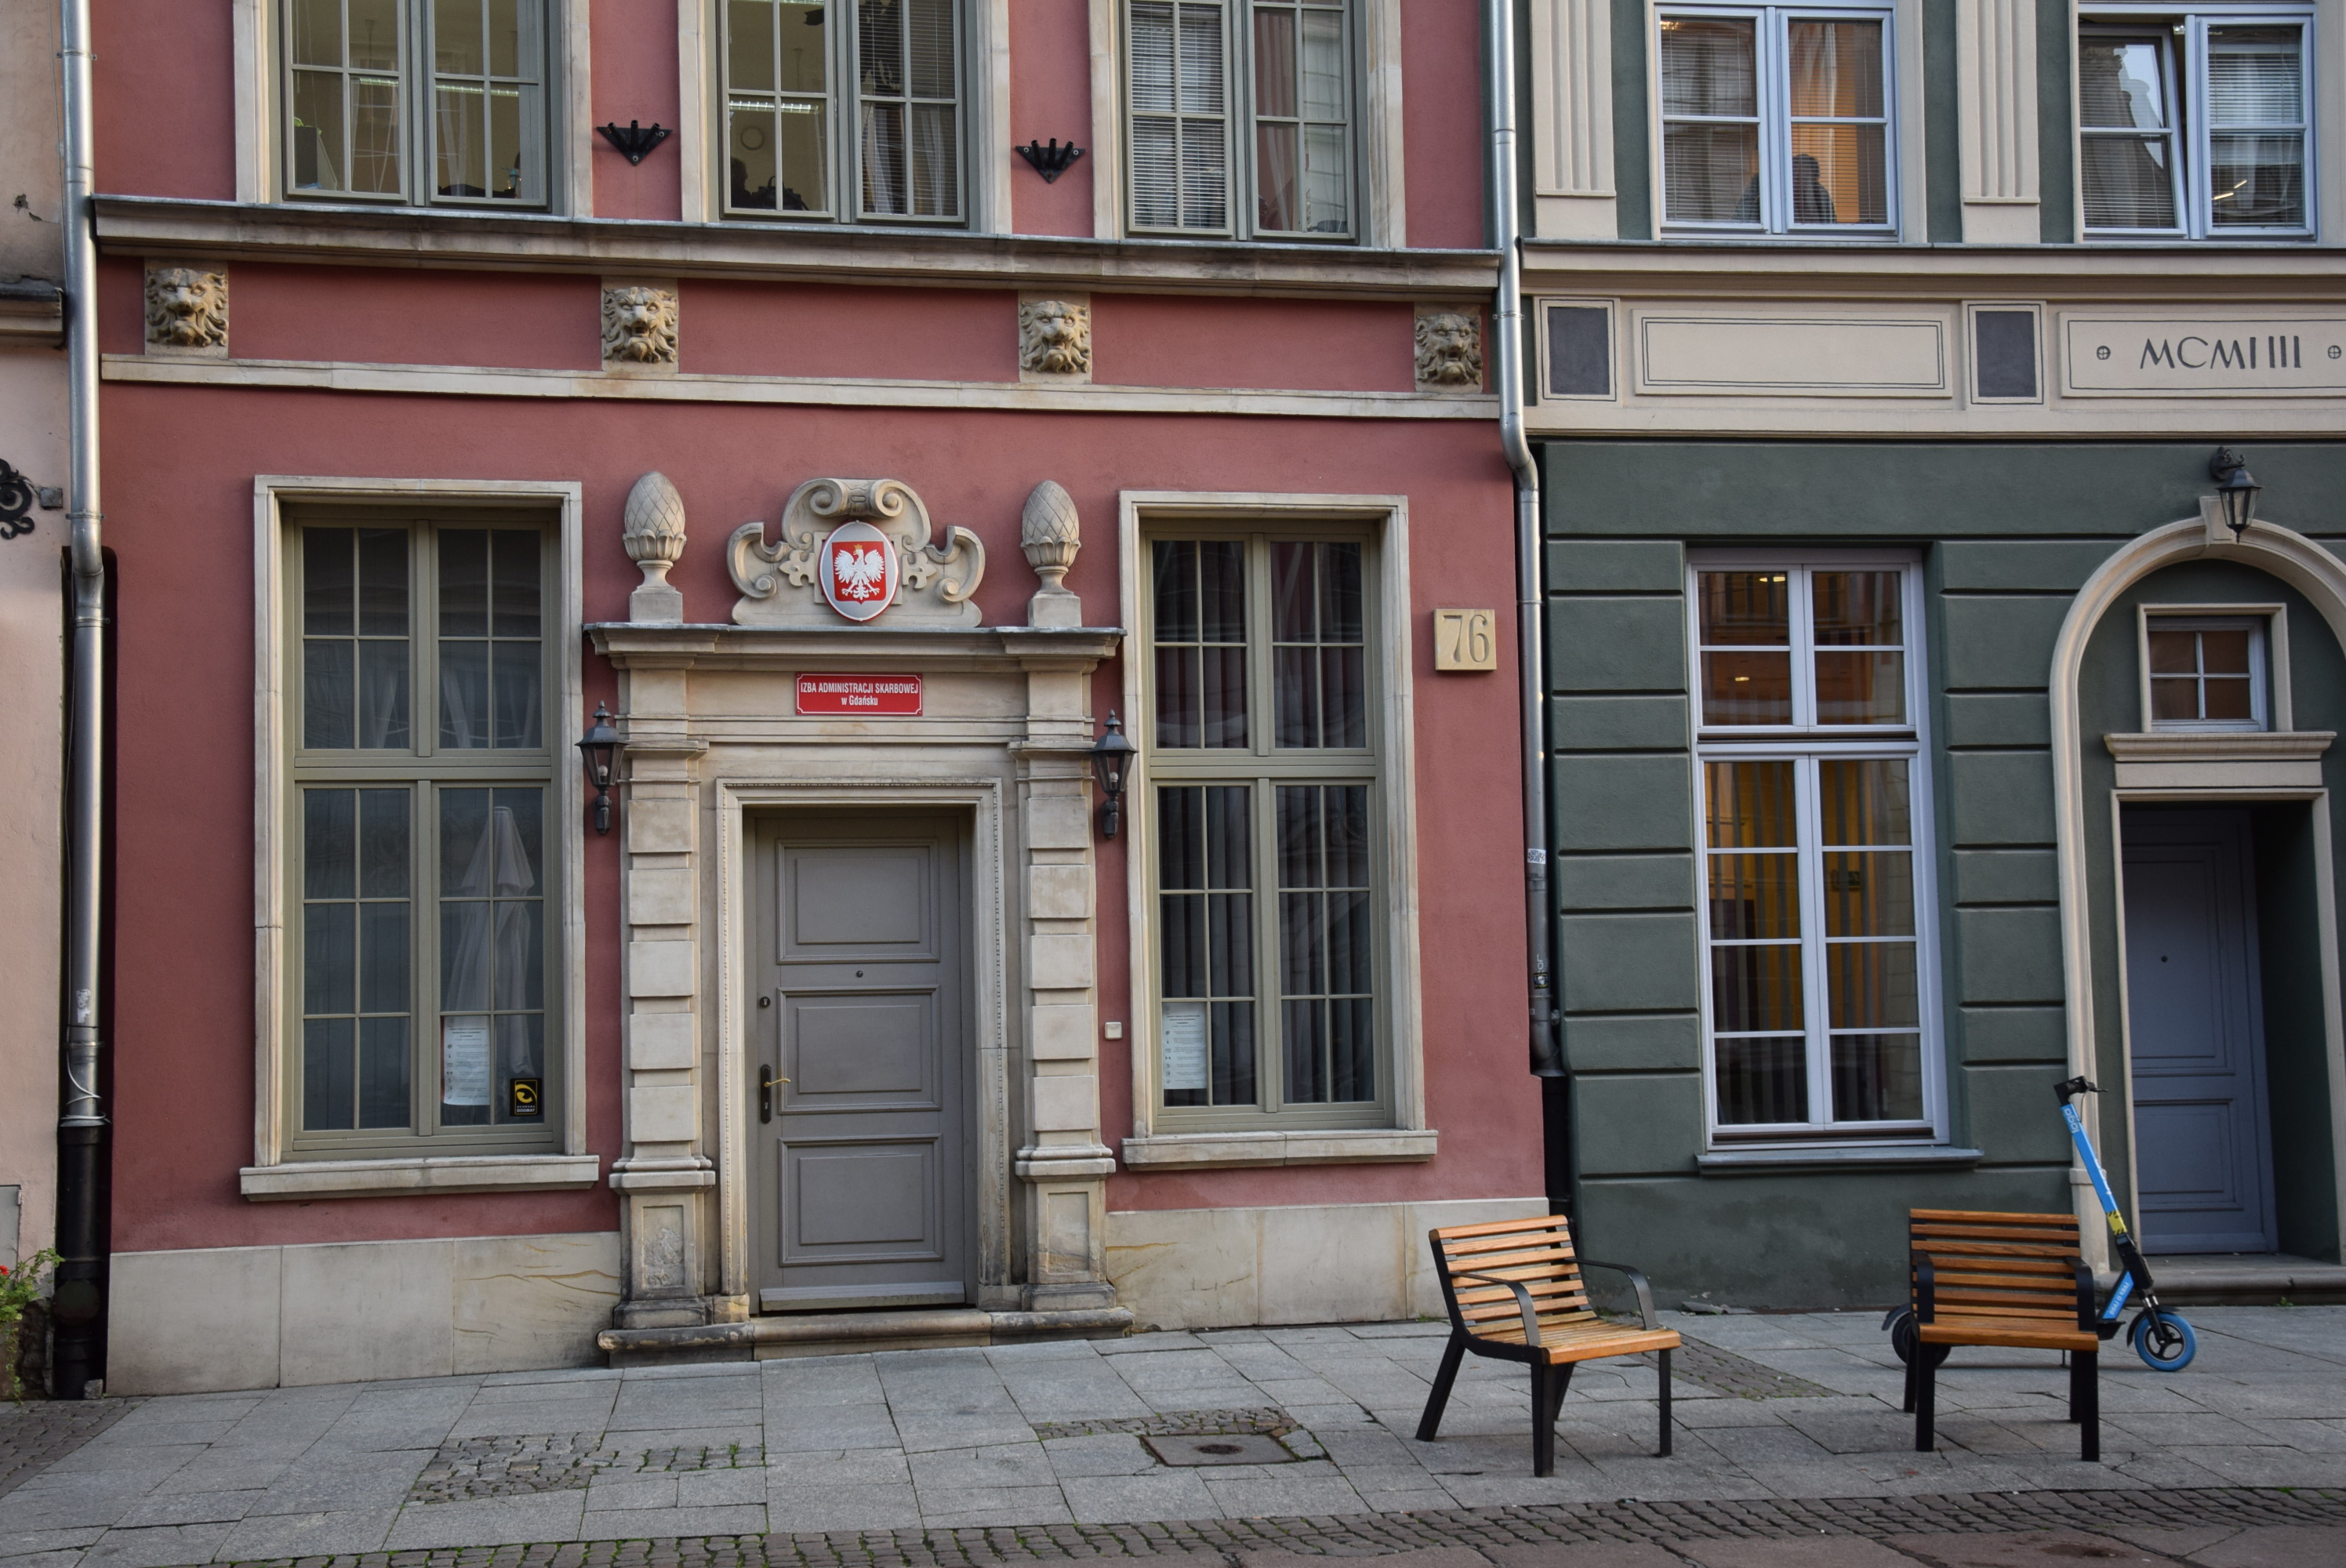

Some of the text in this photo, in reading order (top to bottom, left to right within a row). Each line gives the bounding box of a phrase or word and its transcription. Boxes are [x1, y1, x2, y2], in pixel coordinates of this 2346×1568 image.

[1443, 614, 1490, 663] 76
[801, 682, 918, 694] IZBA ADMINISTRACJI SKARBOWEJ
[841, 695, 878, 706] w Gdańsku
